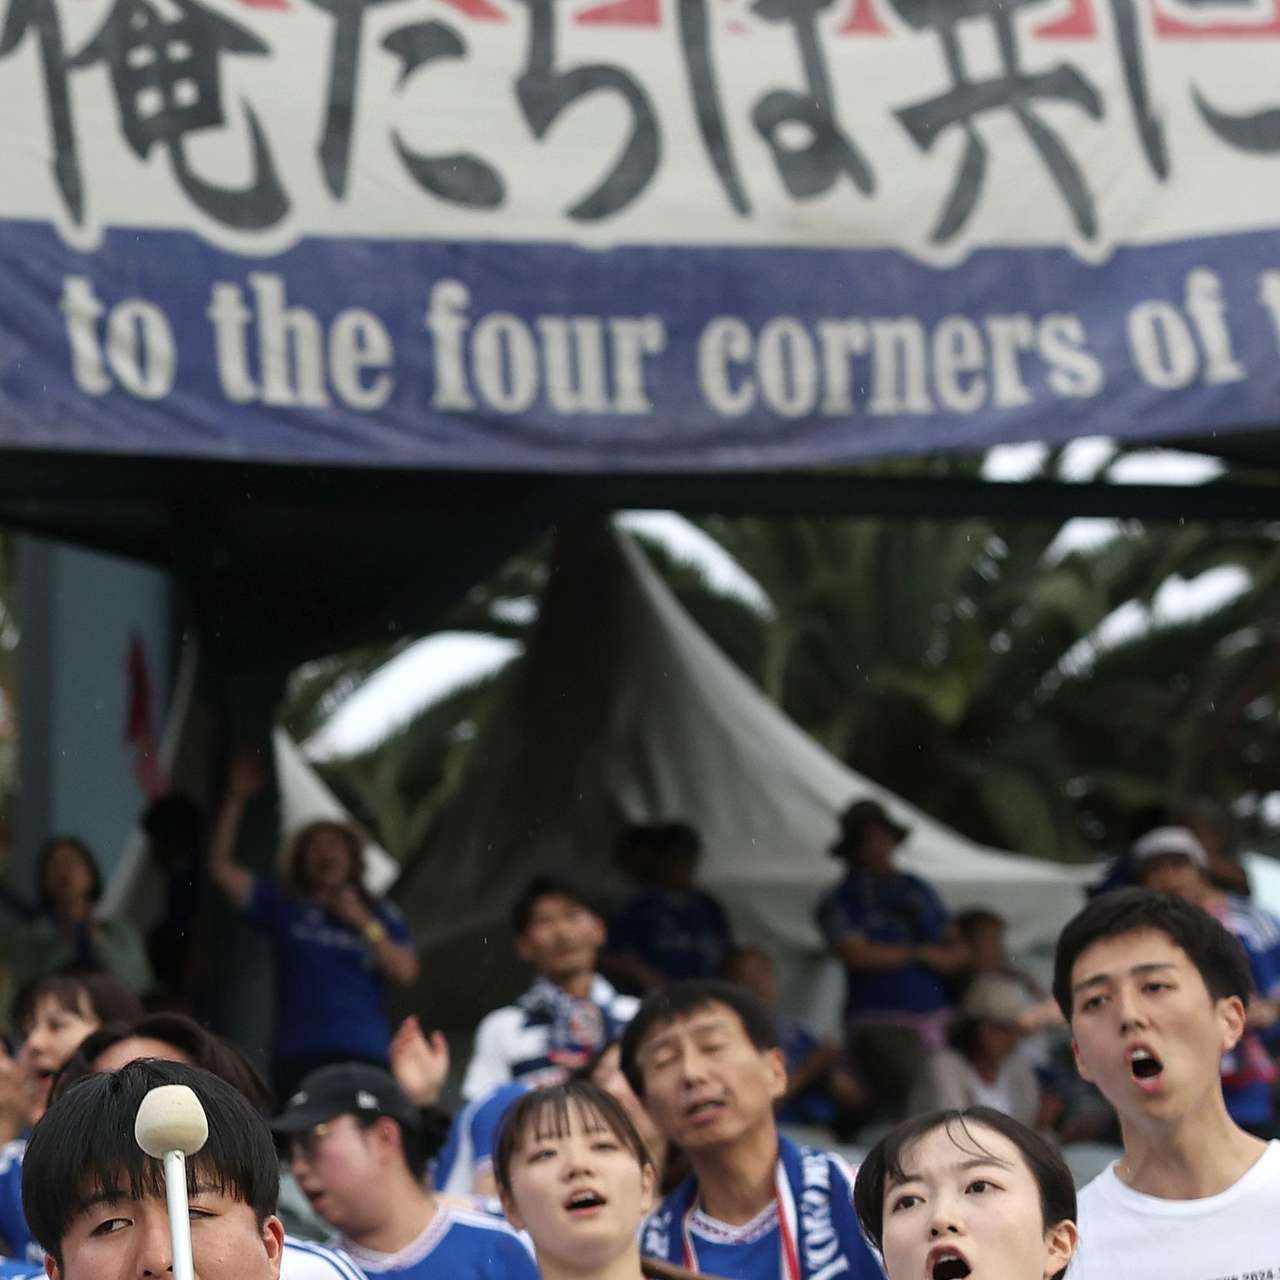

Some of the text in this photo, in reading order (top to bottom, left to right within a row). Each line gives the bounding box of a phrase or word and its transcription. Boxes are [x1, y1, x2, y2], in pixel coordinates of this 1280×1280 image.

[60, 272, 176, 400] to
[205, 272, 393, 410] the
[429, 280, 664, 419] four
[698, 312, 1104, 418] corners
[1128, 267, 1245, 389] of
